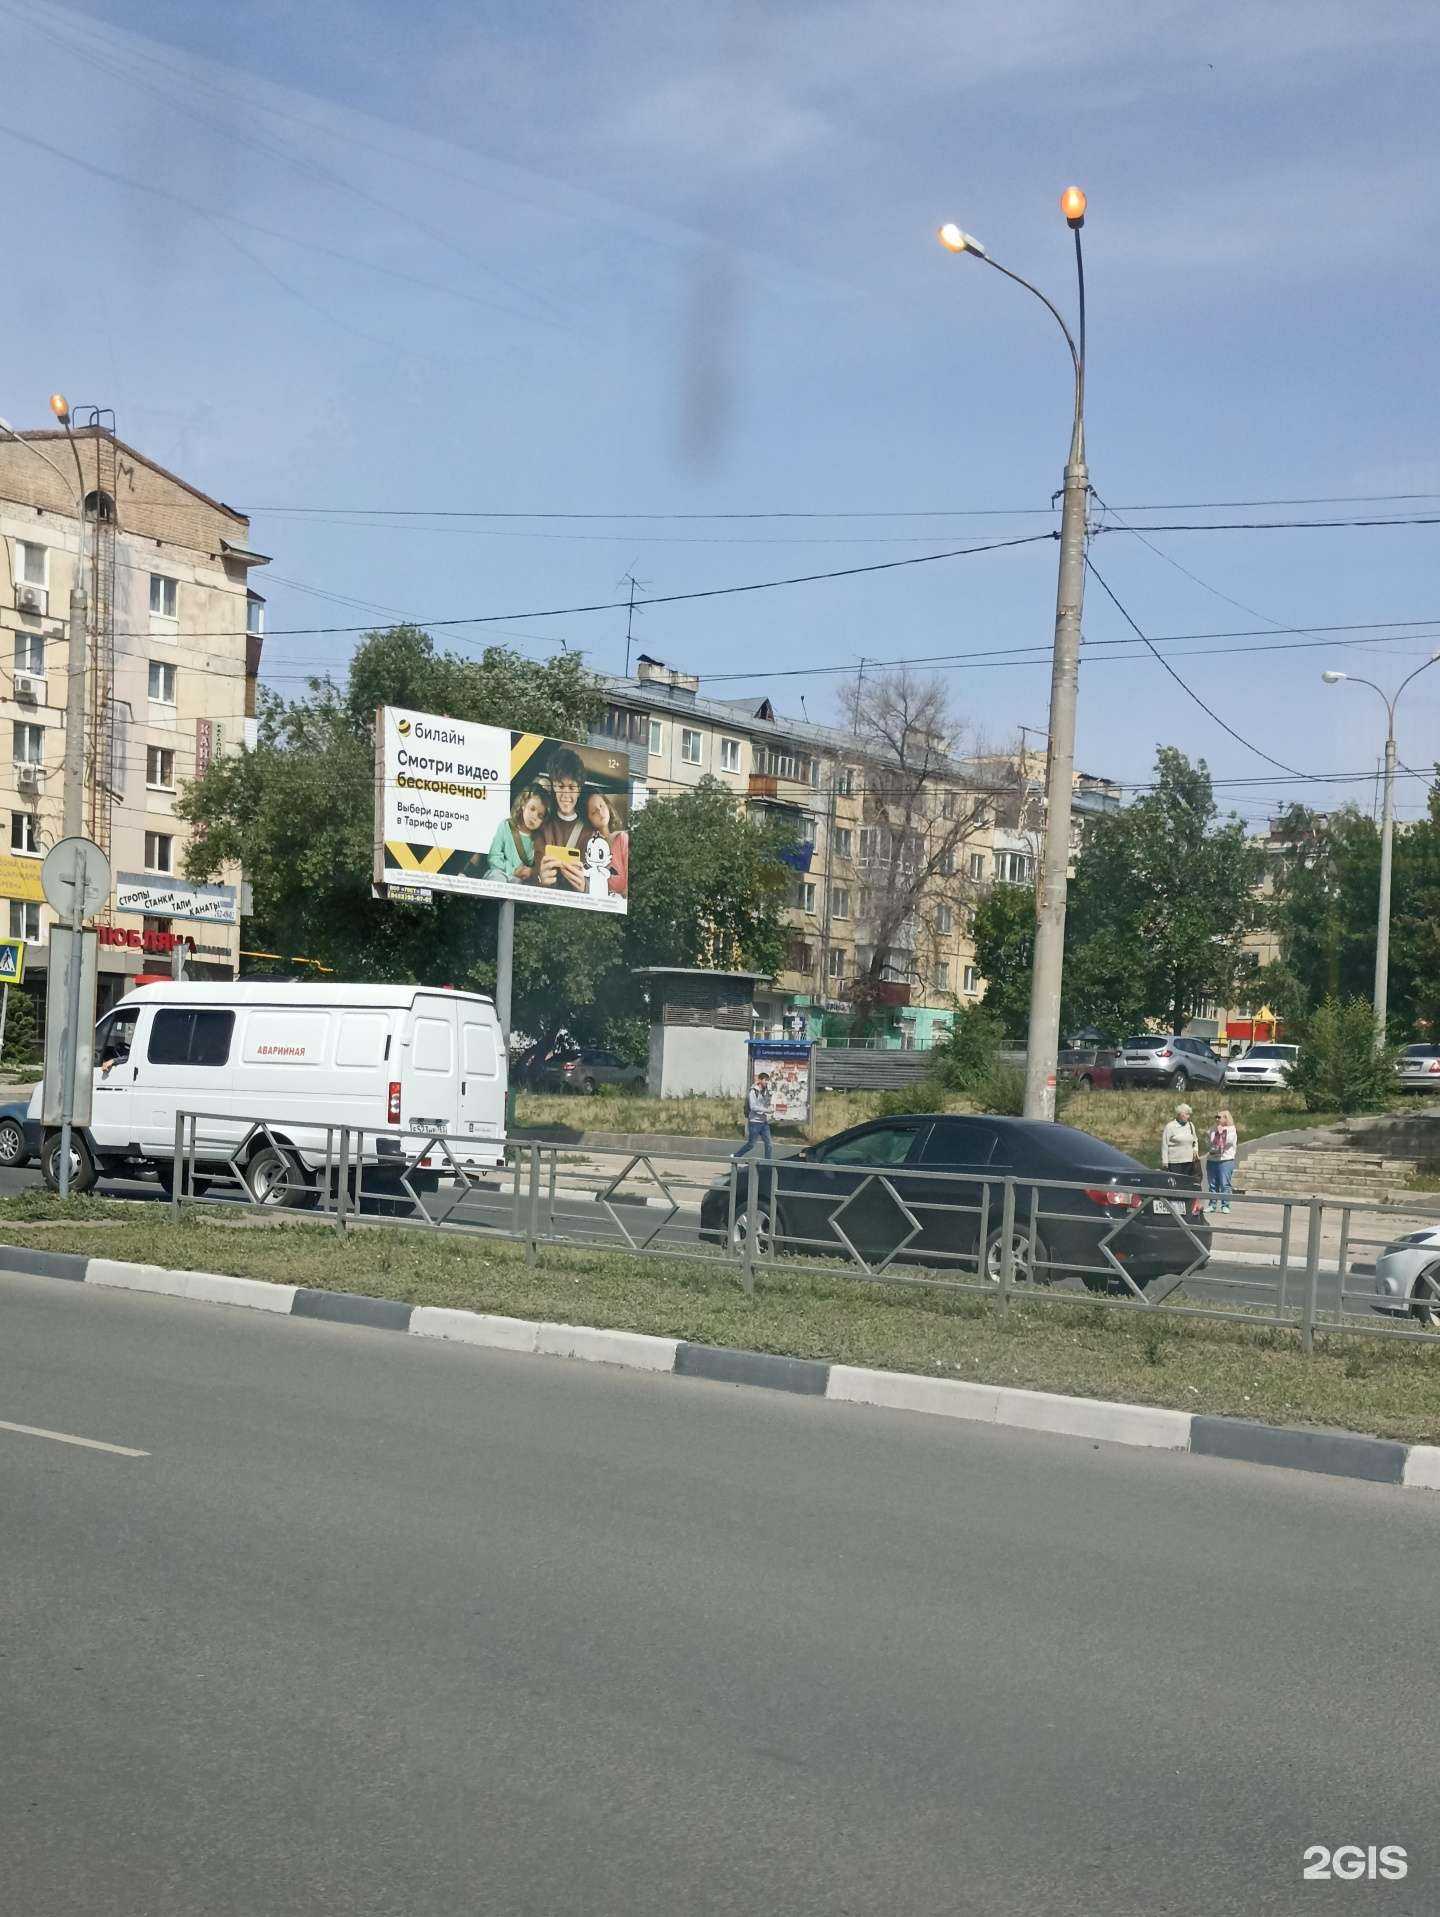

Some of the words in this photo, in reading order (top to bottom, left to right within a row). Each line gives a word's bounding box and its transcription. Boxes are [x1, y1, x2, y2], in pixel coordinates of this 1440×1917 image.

[415, 723, 464, 745] билайн
[397, 749, 453, 775] Смотри
[457, 763, 499, 781] видео
[608, 759, 620, 769] 12+
[397, 772, 486, 800] бесконечно!
[397, 801, 431, 816] Выбери
[433, 808, 470, 821] дракона
[396, 816, 402, 824] в
[404, 815, 438, 830] Тарифе
[440, 822, 453, 831] UP
[119, 890, 150, 906] СТРОПЫ
[144, 893, 175, 909] СТАНКИ
[189, 901, 221, 916] КАНАТЫ
[96, 925, 197, 954] ЛЮБЛЯНА
